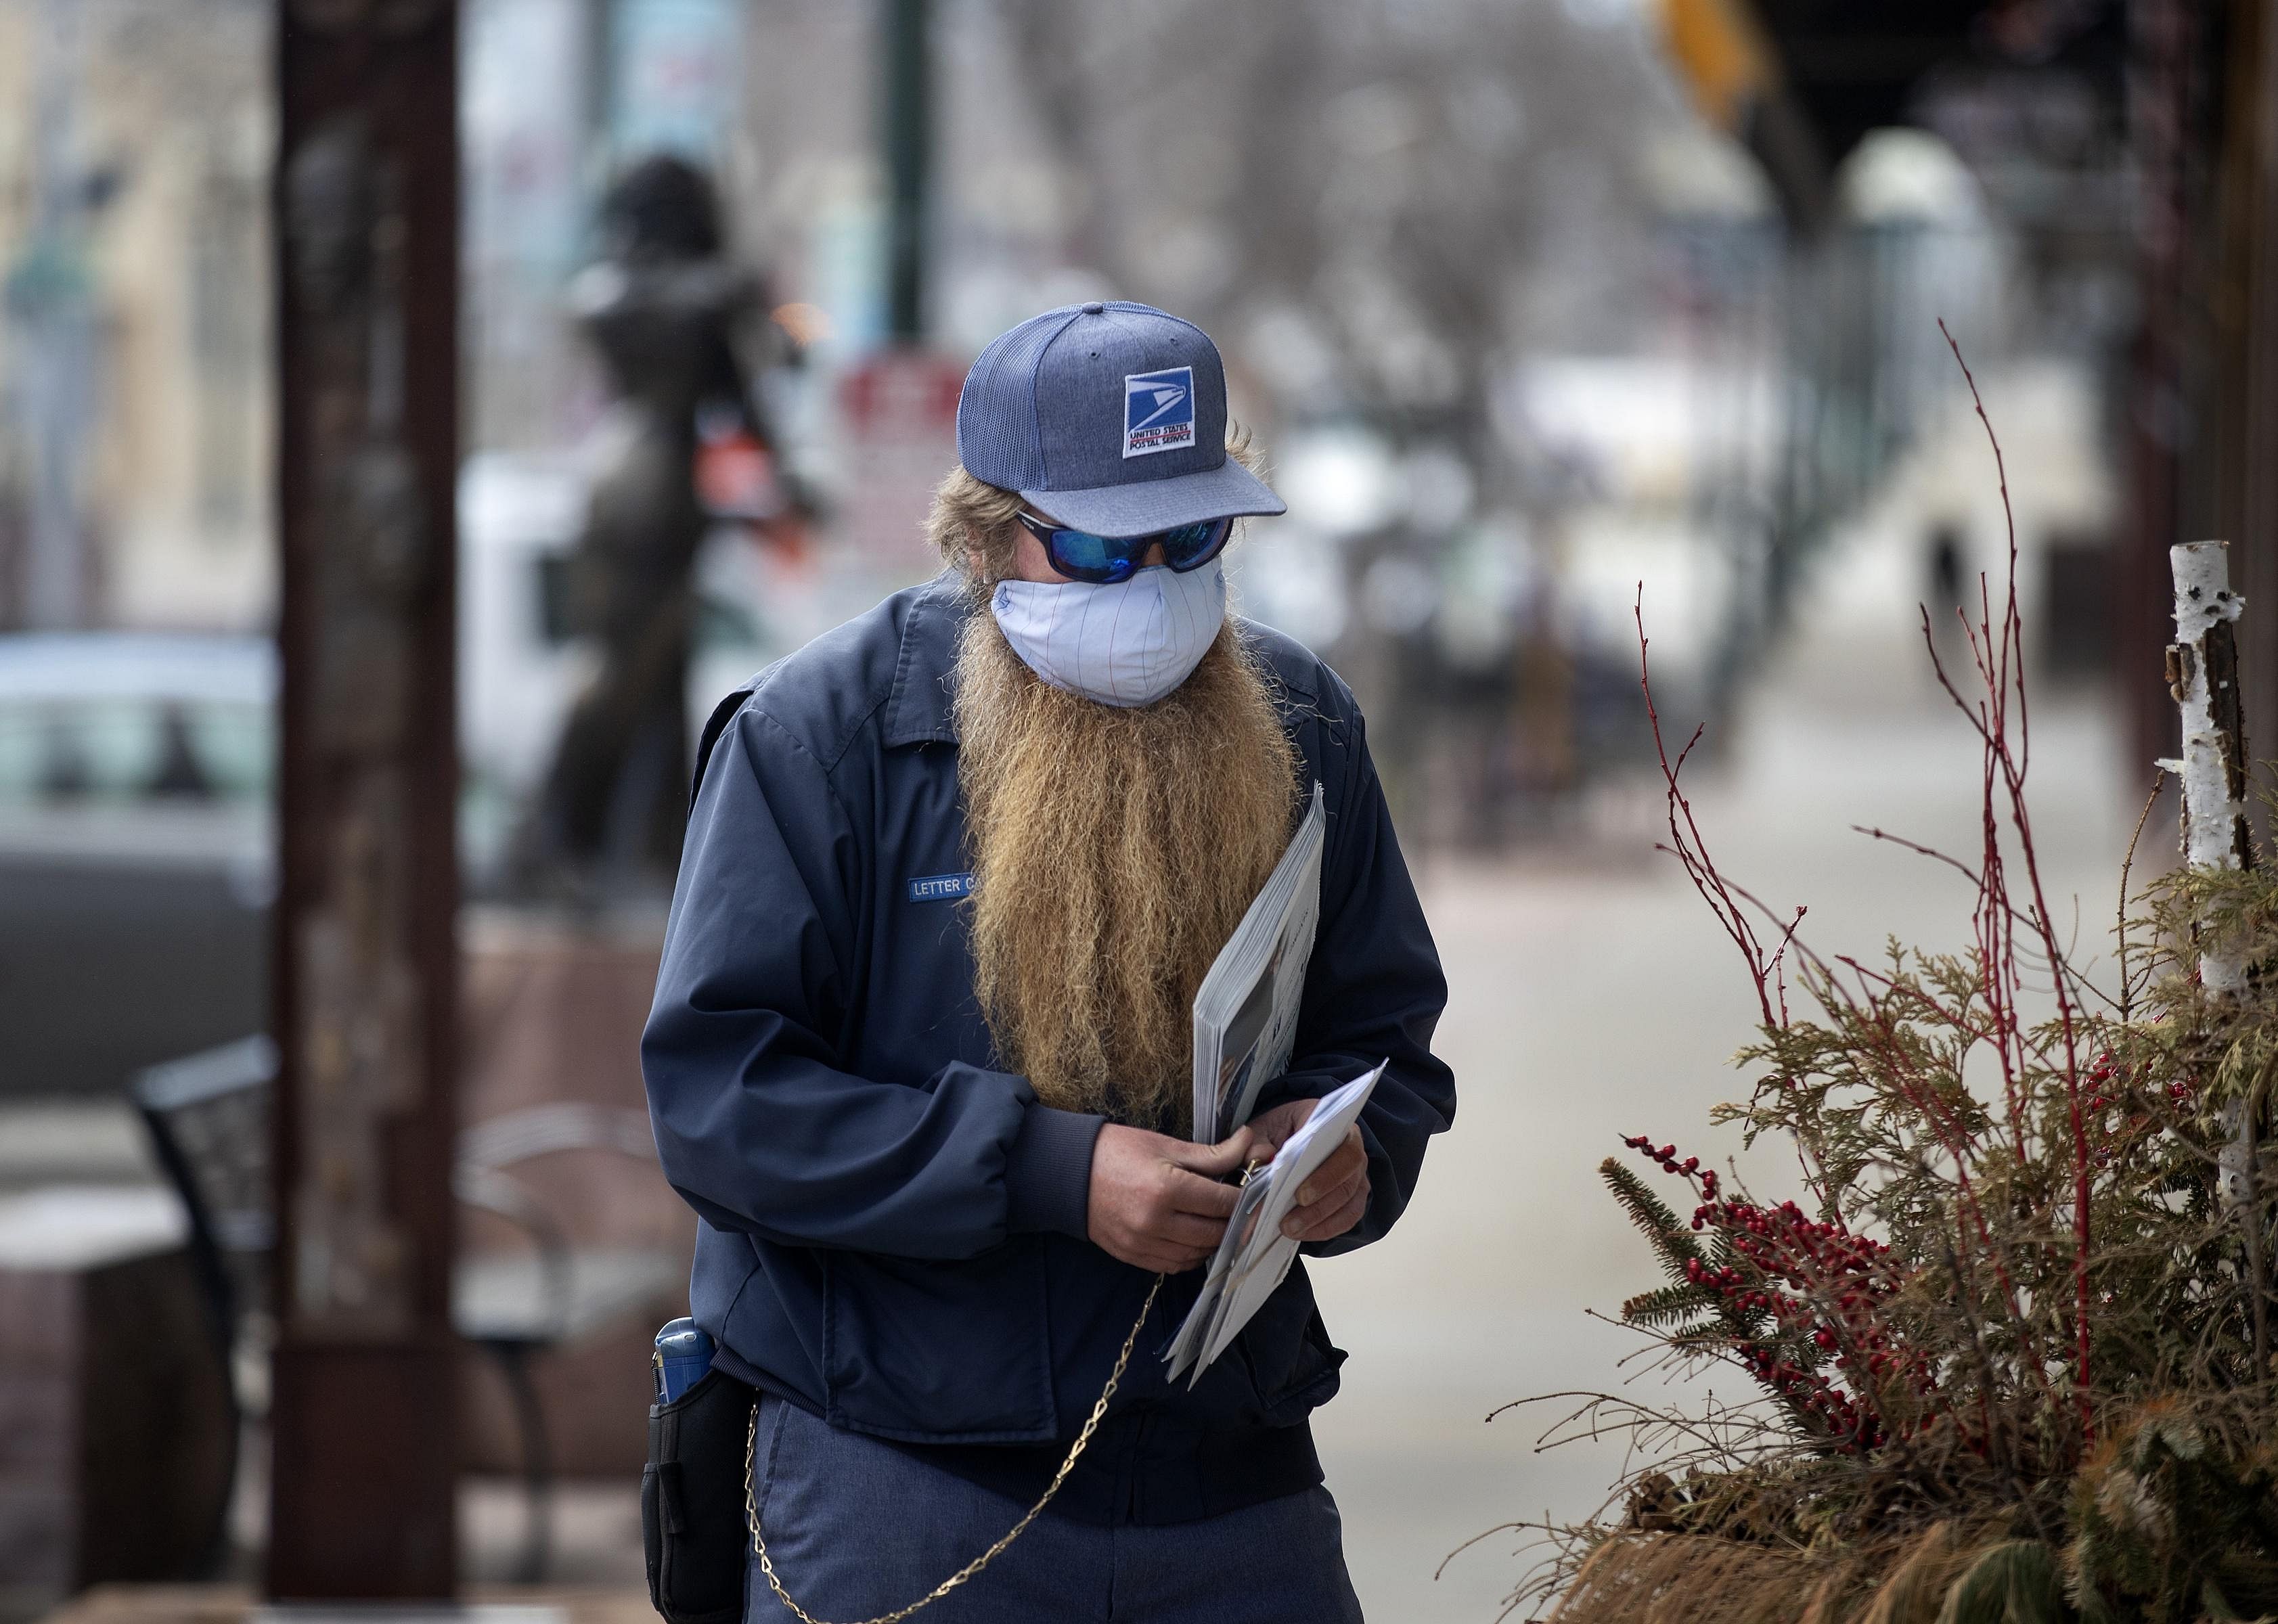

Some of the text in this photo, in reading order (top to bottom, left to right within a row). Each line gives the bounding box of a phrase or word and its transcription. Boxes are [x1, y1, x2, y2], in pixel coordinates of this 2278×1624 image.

[1130, 424, 1188, 439] UNITED STATES
[1130, 433, 1190, 450] POSTAL SERVICE
[914, 879, 960, 895] LETTER
